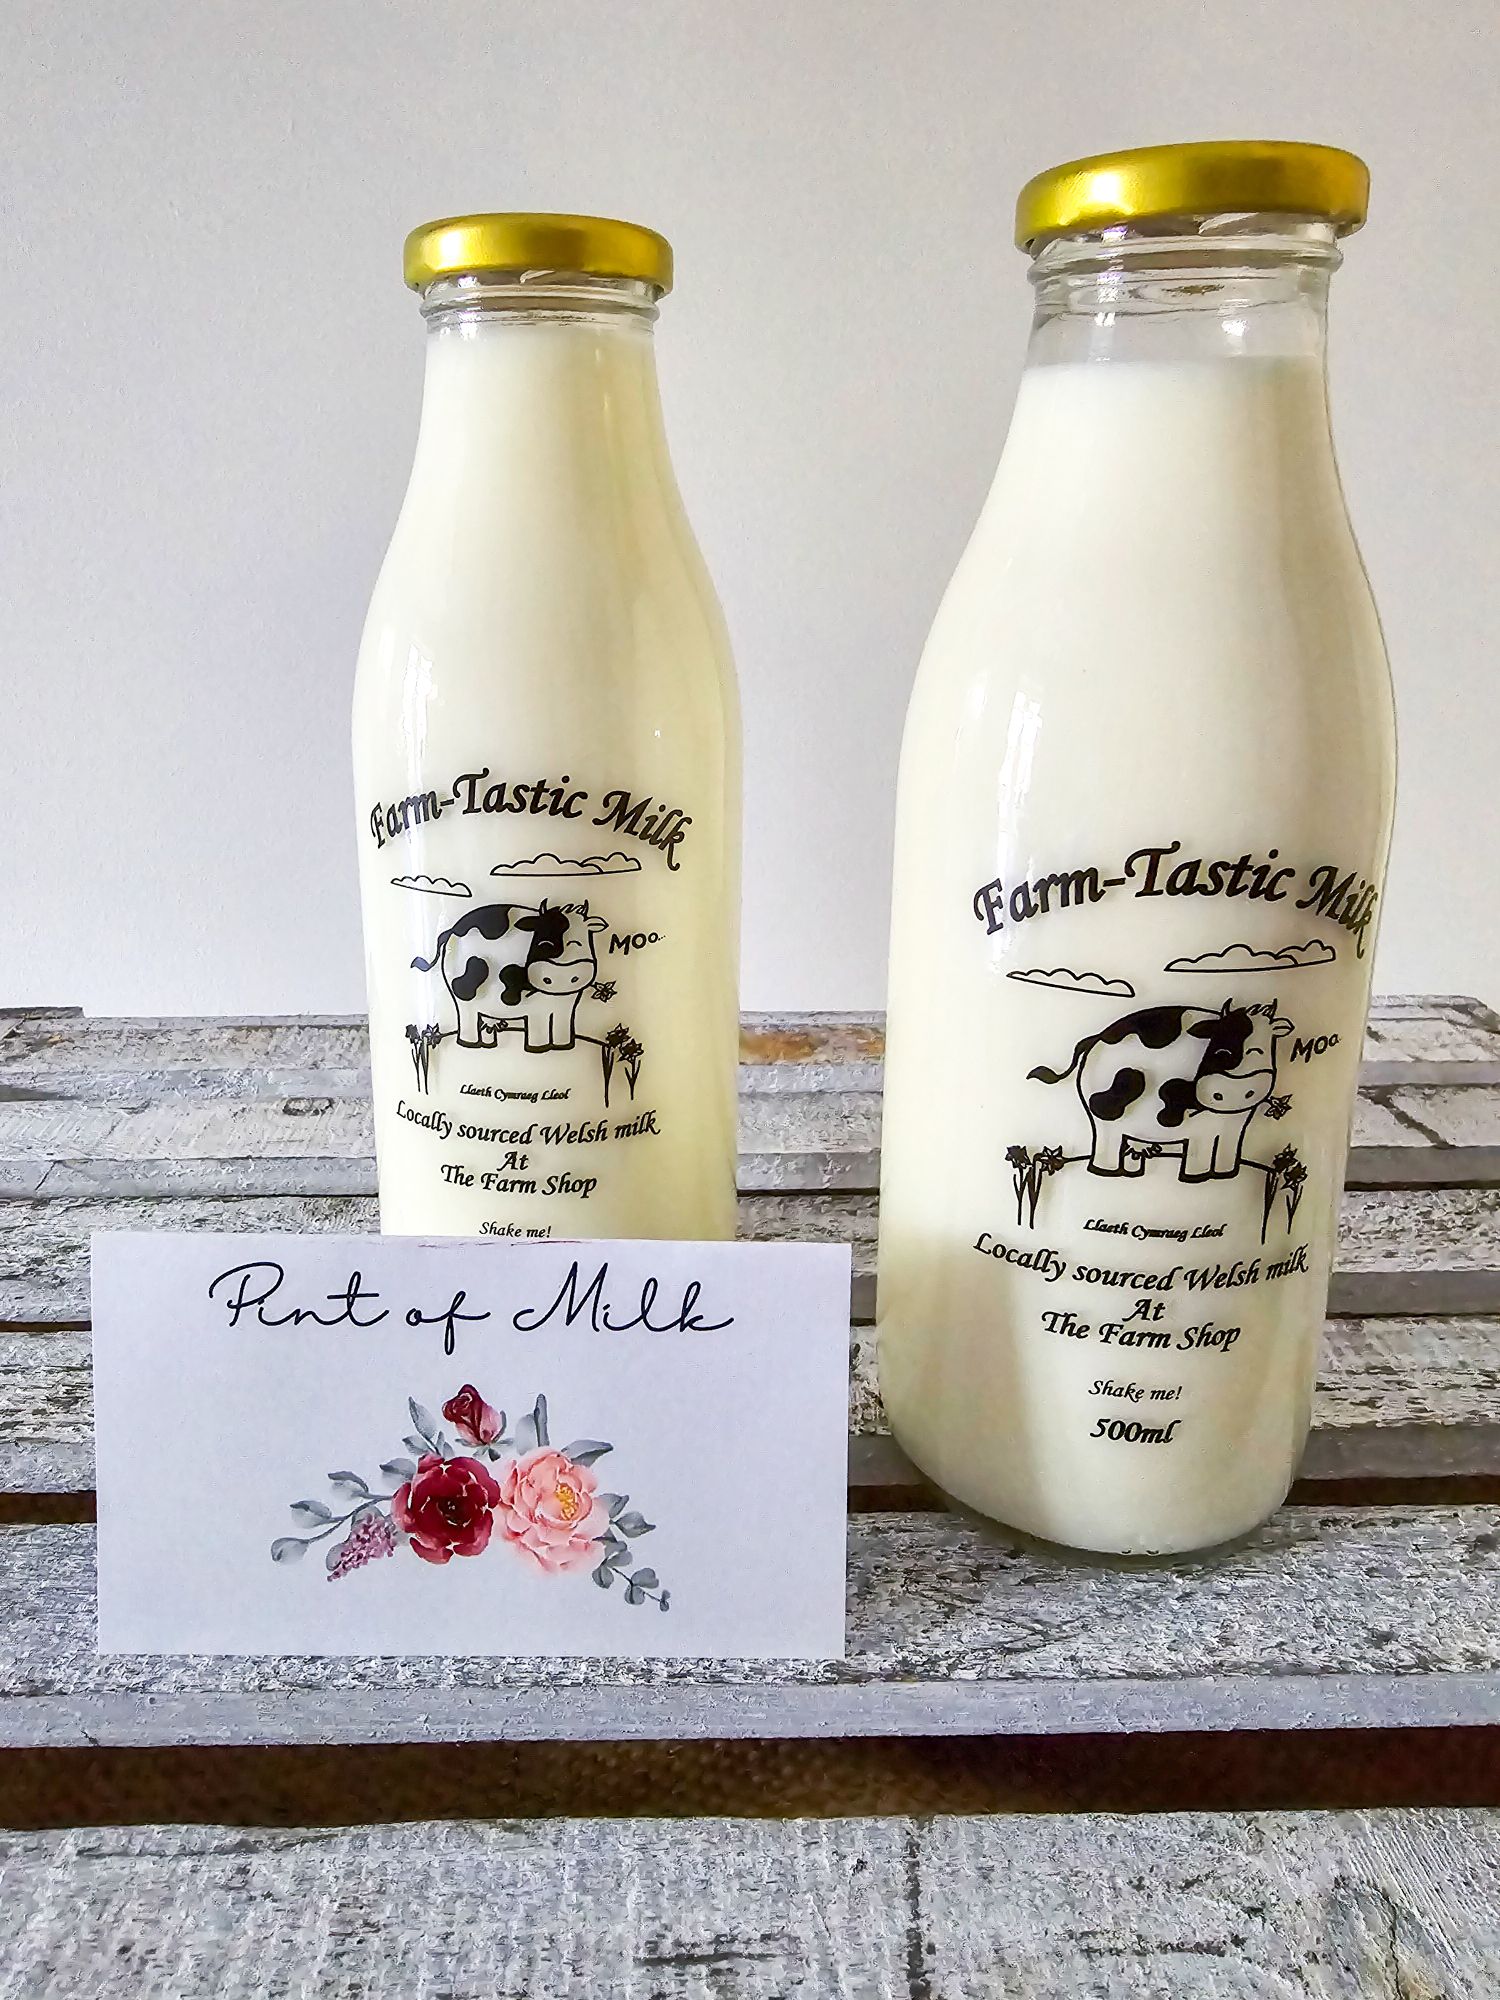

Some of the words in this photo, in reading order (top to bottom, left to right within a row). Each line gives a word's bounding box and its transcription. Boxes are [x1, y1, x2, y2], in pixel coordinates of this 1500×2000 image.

[369, 767, 589, 850] Farm-Tastic
[592, 789, 693, 872] Milk
[973, 840, 1297, 937] Farm-Tastic
[1295, 865, 1379, 960] Milk
[459, 1083, 493, 1098] Llaeth
[540, 1087, 572, 1101] Lleol
[396, 1100, 453, 1140] Locally
[456, 1123, 539, 1145] sourced
[539, 1119, 608, 1146] Welsh
[614, 1110, 661, 1140] milk
[496, 1150, 529, 1172] At
[440, 1164, 475, 1188] The
[480, 1172, 538, 1195] Farm
[541, 1172, 598, 1199] Shop
[478, 1221, 523, 1239] Shake
[525, 1225, 552, 1239] me!
[1082, 1218, 1130, 1235] Llaeth
[1189, 1223, 1228, 1239] Lleol
[972, 1232, 1067, 1283] Locally
[1072, 1264, 1184, 1292] sourced
[1183, 1259, 1262, 1292] Welsh
[1264, 1243, 1310, 1282] milk
[208, 1261, 390, 1328] Pint
[405, 1290, 492, 1356] of
[512, 1260, 736, 1333] Milk
[1121, 1297, 1166, 1322] At
[1041, 1310, 1090, 1340] The
[1098, 1322, 1171, 1349] Farm
[1175, 1321, 1242, 1353] Shop
[1087, 1379, 1145, 1404] Shake
[1149, 1385, 1183, 1401] me!
[1089, 1417, 1183, 1445] 500ml
